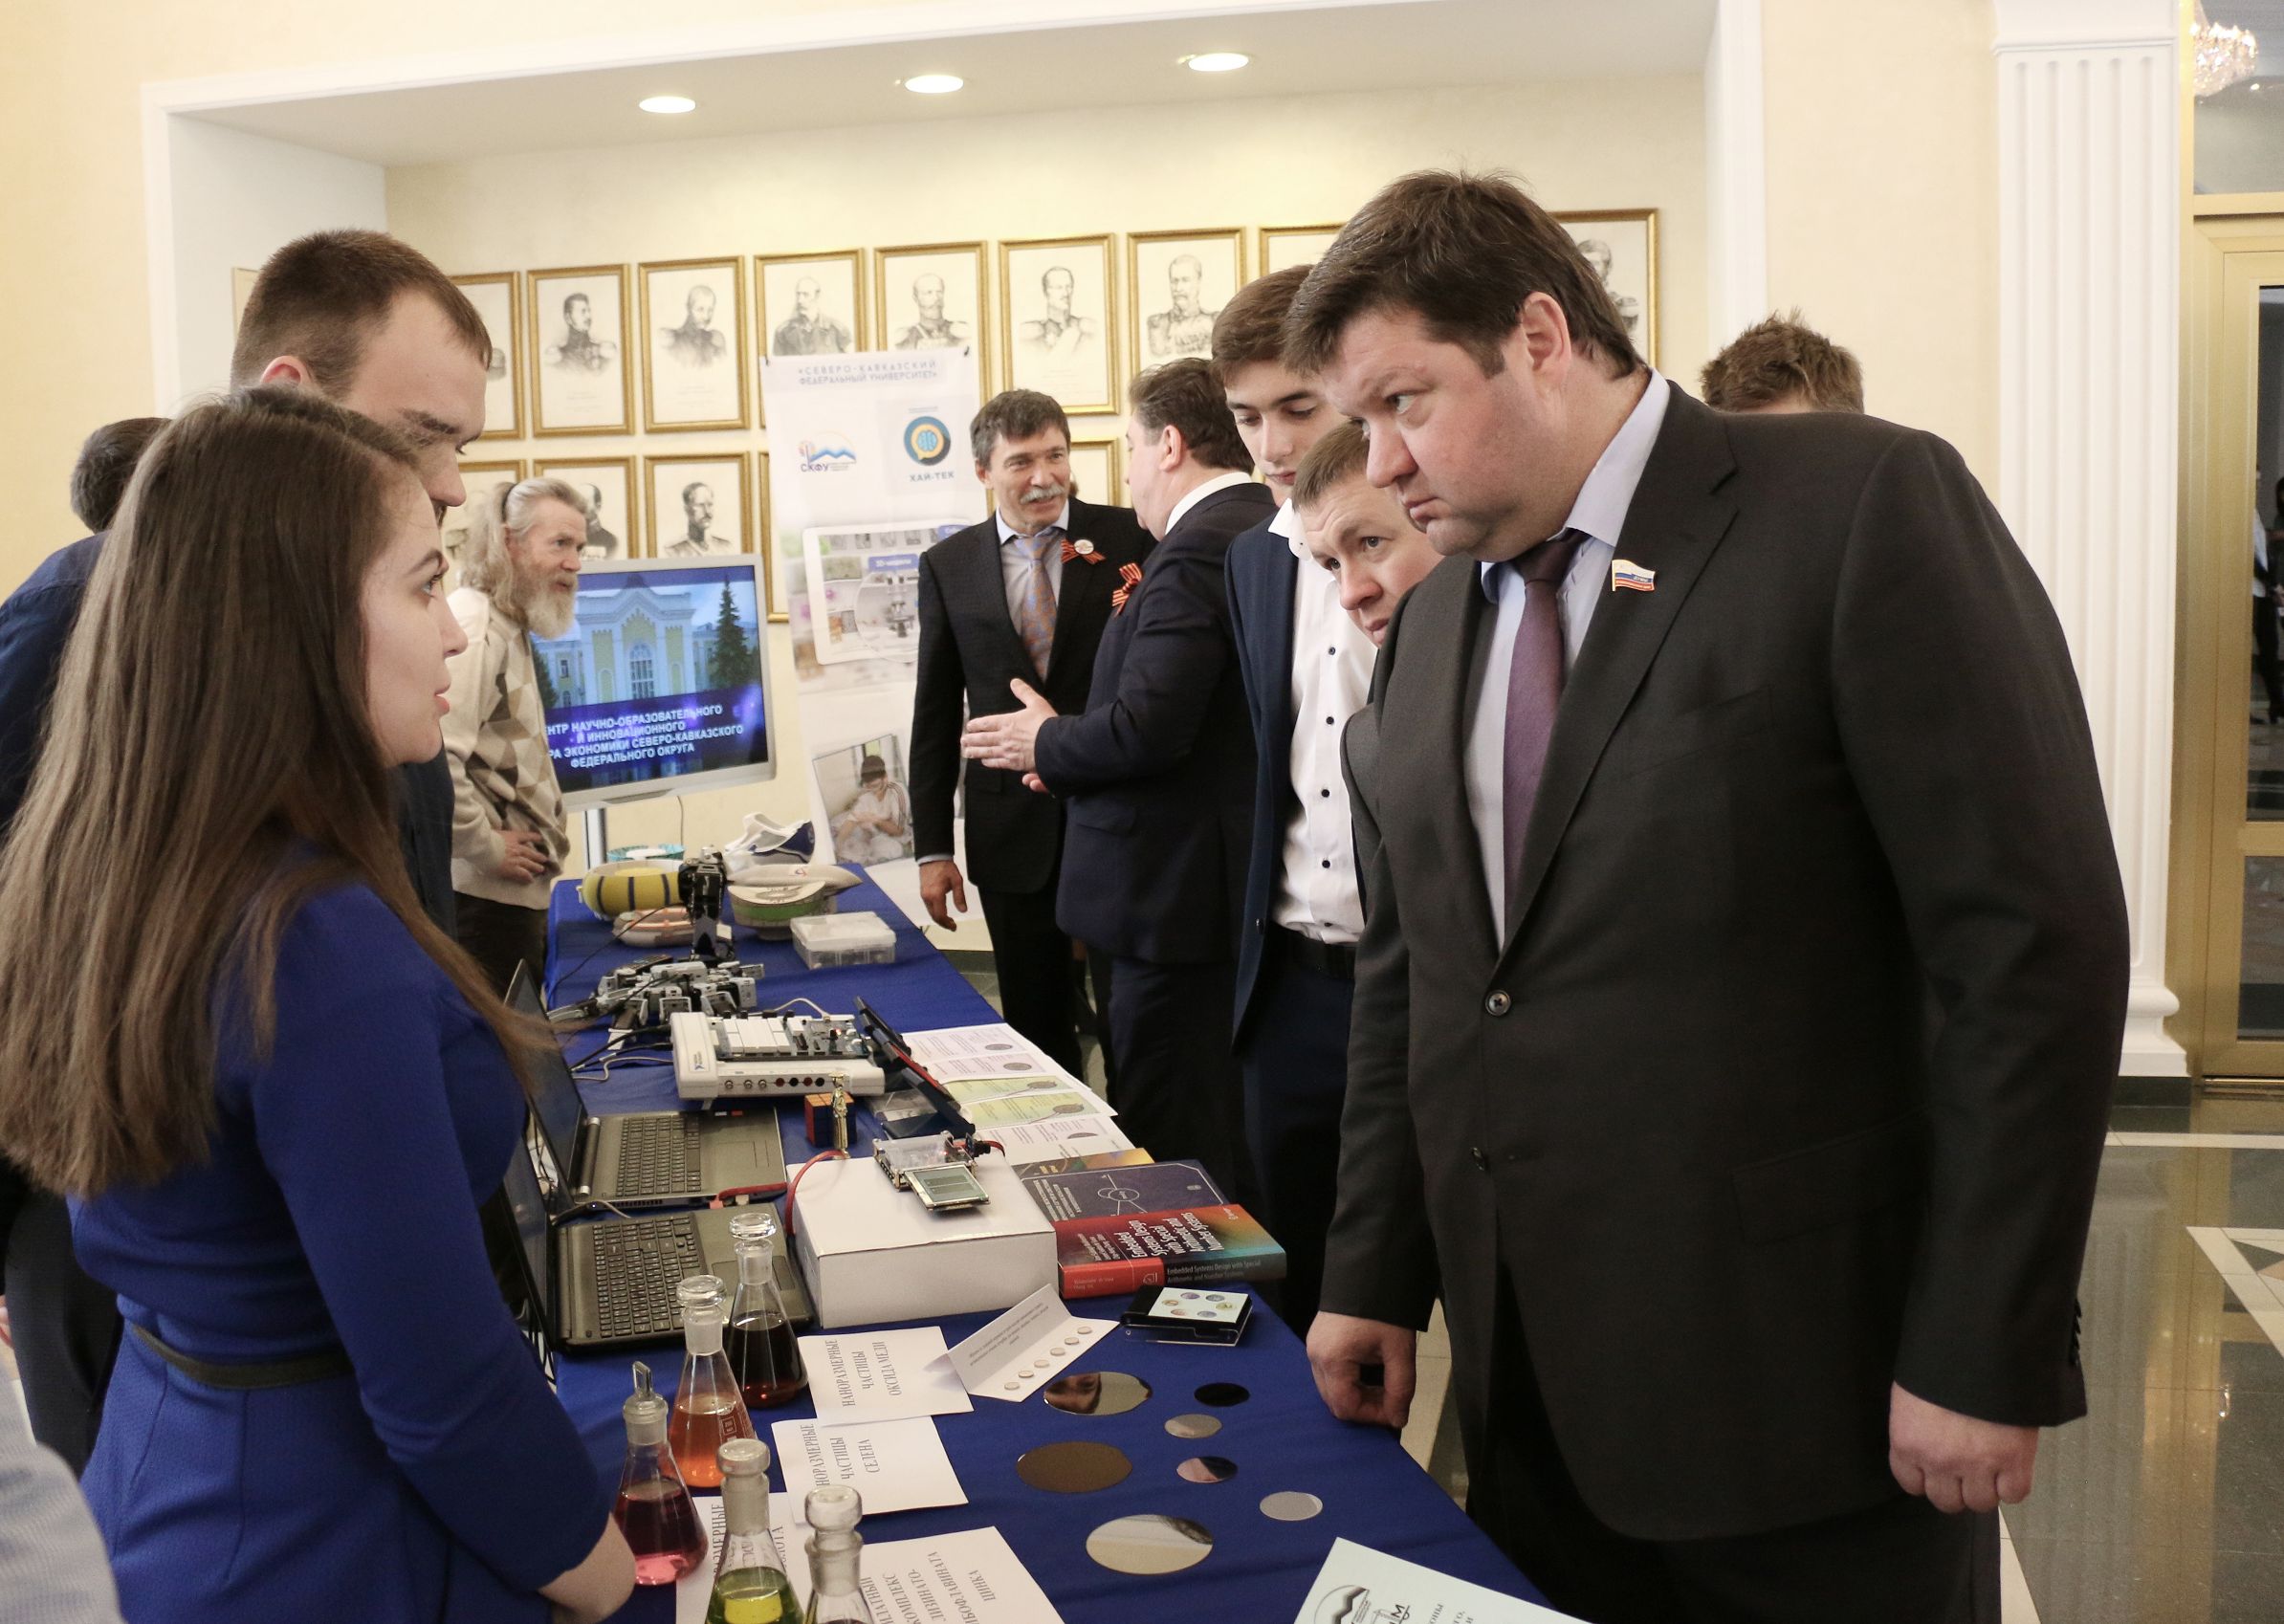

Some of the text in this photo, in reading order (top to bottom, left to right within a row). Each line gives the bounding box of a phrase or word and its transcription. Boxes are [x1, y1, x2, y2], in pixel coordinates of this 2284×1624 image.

[799, 374, 867, 384] ФЕДЕРАЛЬНЫЙ
[800, 463, 829, 472] СКФУ
[909, 471, 955, 482] ХАЙ-ТЕК
[571, 705, 723, 733] НАУЧНО-ОБРАЗОВАТЕЛЬНОГО
[586, 721, 686, 742] ИННОВАЦИОННОГО
[563, 739, 630, 757] ЭКОНОМИКИ
[631, 725, 743, 748] СЕВЕРО-КАВКАЗСКОГО
[570, 748, 655, 768] ФЕДЕРАЛЬНОГО
[657, 742, 695, 757] ОКРУГА
[1113, 1232, 1148, 1257] Embedded
[1129, 1220, 1169, 1256] Systems Design
[1149, 1225, 1186, 1254] with Special
[824, 1339, 856, 1407] НАНОРАЗМЕРНЫЕ
[851, 1350, 874, 1390] ЧАСТИЦЫ
[871, 1341, 902, 1396] ОКСИДА МЕДИ
[800, 1423, 830, 1486] НОРАЗМЕРНЫЕ
[829, 1437, 854, 1480] ЧАСТИЦЫ
[857, 1438, 880, 1473] СЕЛЕНА
[907, 1569, 947, 1622] ЛИЗИНАТО-
[968, 1569, 996, 1602] ЦИНКА
